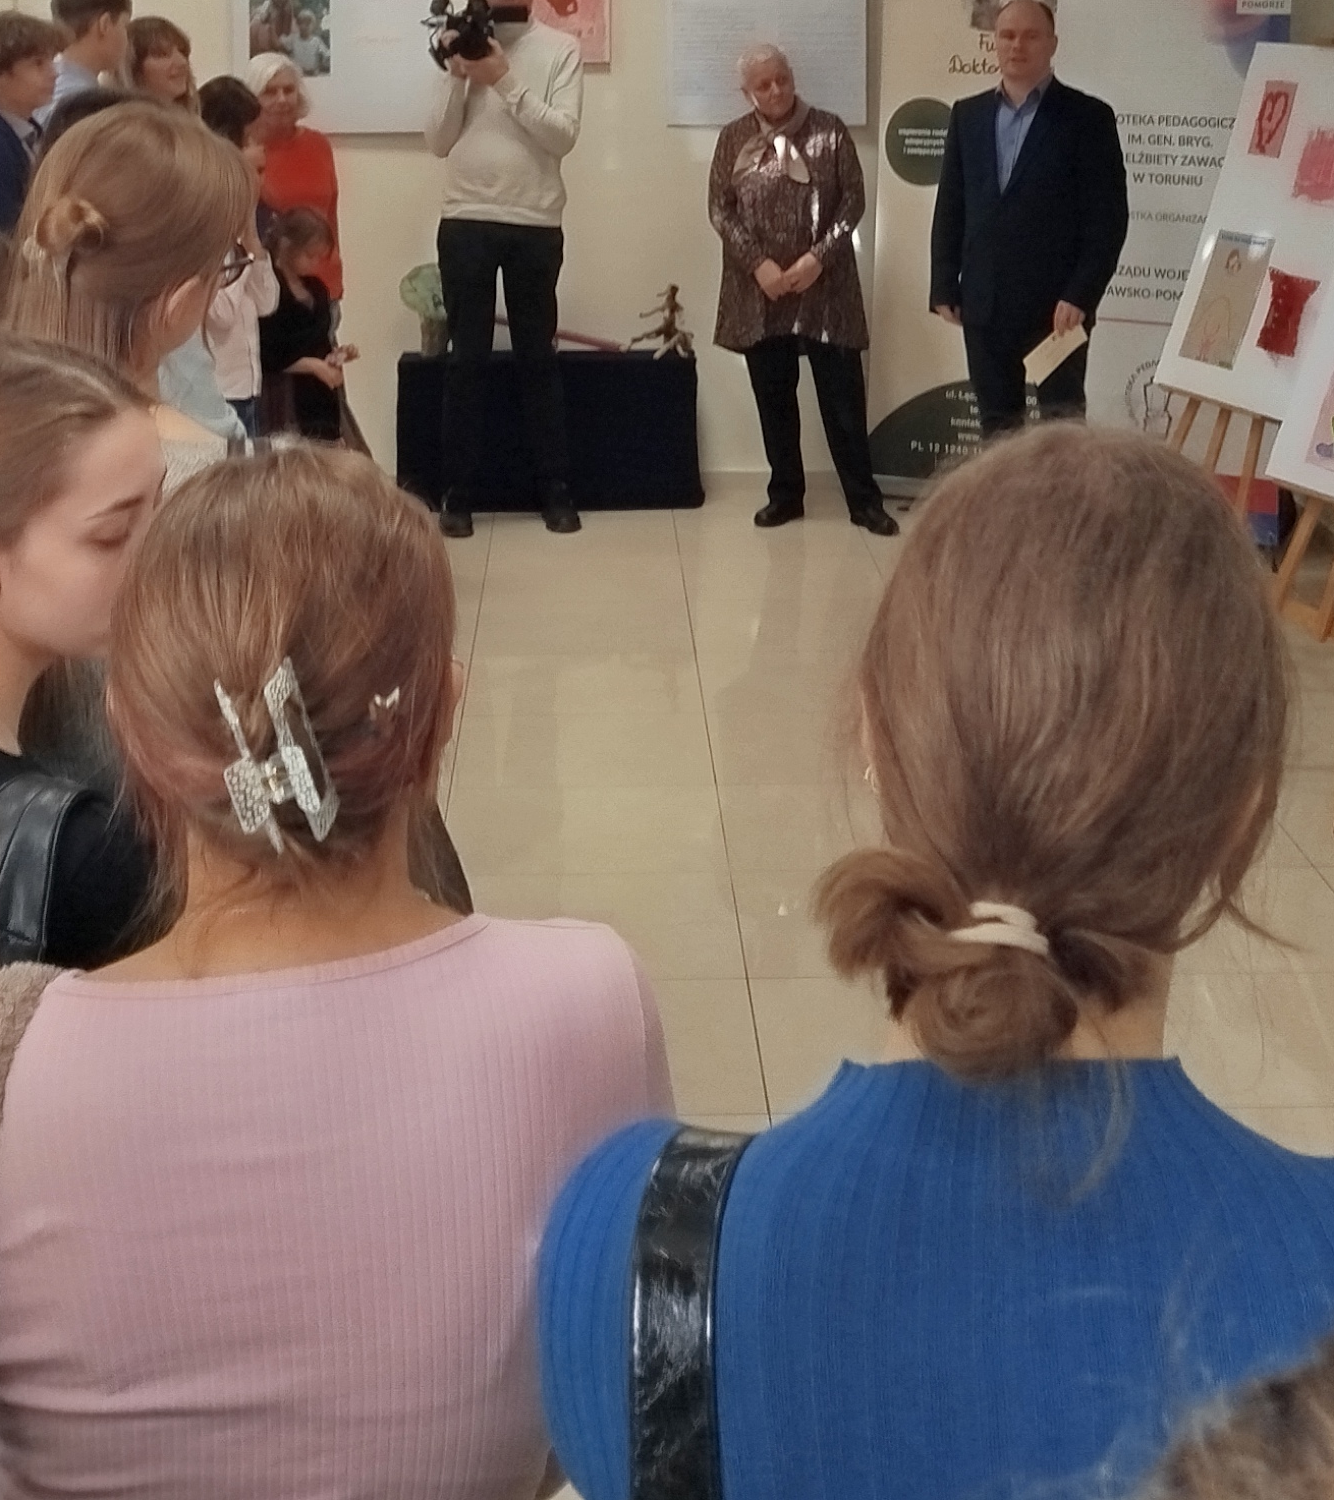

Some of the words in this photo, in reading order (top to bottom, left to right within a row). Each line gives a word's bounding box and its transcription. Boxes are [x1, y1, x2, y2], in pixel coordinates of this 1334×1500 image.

[1242, 0, 1285, 9] POMORZE
[979, 33, 995, 52] Fu
[1116, 113, 1155, 126] OTEKA
[1158, 114, 1237, 130] PEDAGOGICZ
[1127, 133, 1145, 145] IM.
[1147, 134, 1175, 147] GEN.
[1178, 134, 1214, 149] BRYG.
[1180, 155, 1225, 169] ZAWAC
[1132, 172, 1145, 184] W
[1148, 172, 1204, 187] TORUNIU
[1114, 265, 1151, 279] ZĄDU
[1154, 267, 1190, 281] WOJE
[1107, 285, 1184, 302] AWSKO-POM
[950, 417, 981, 429] kontak
